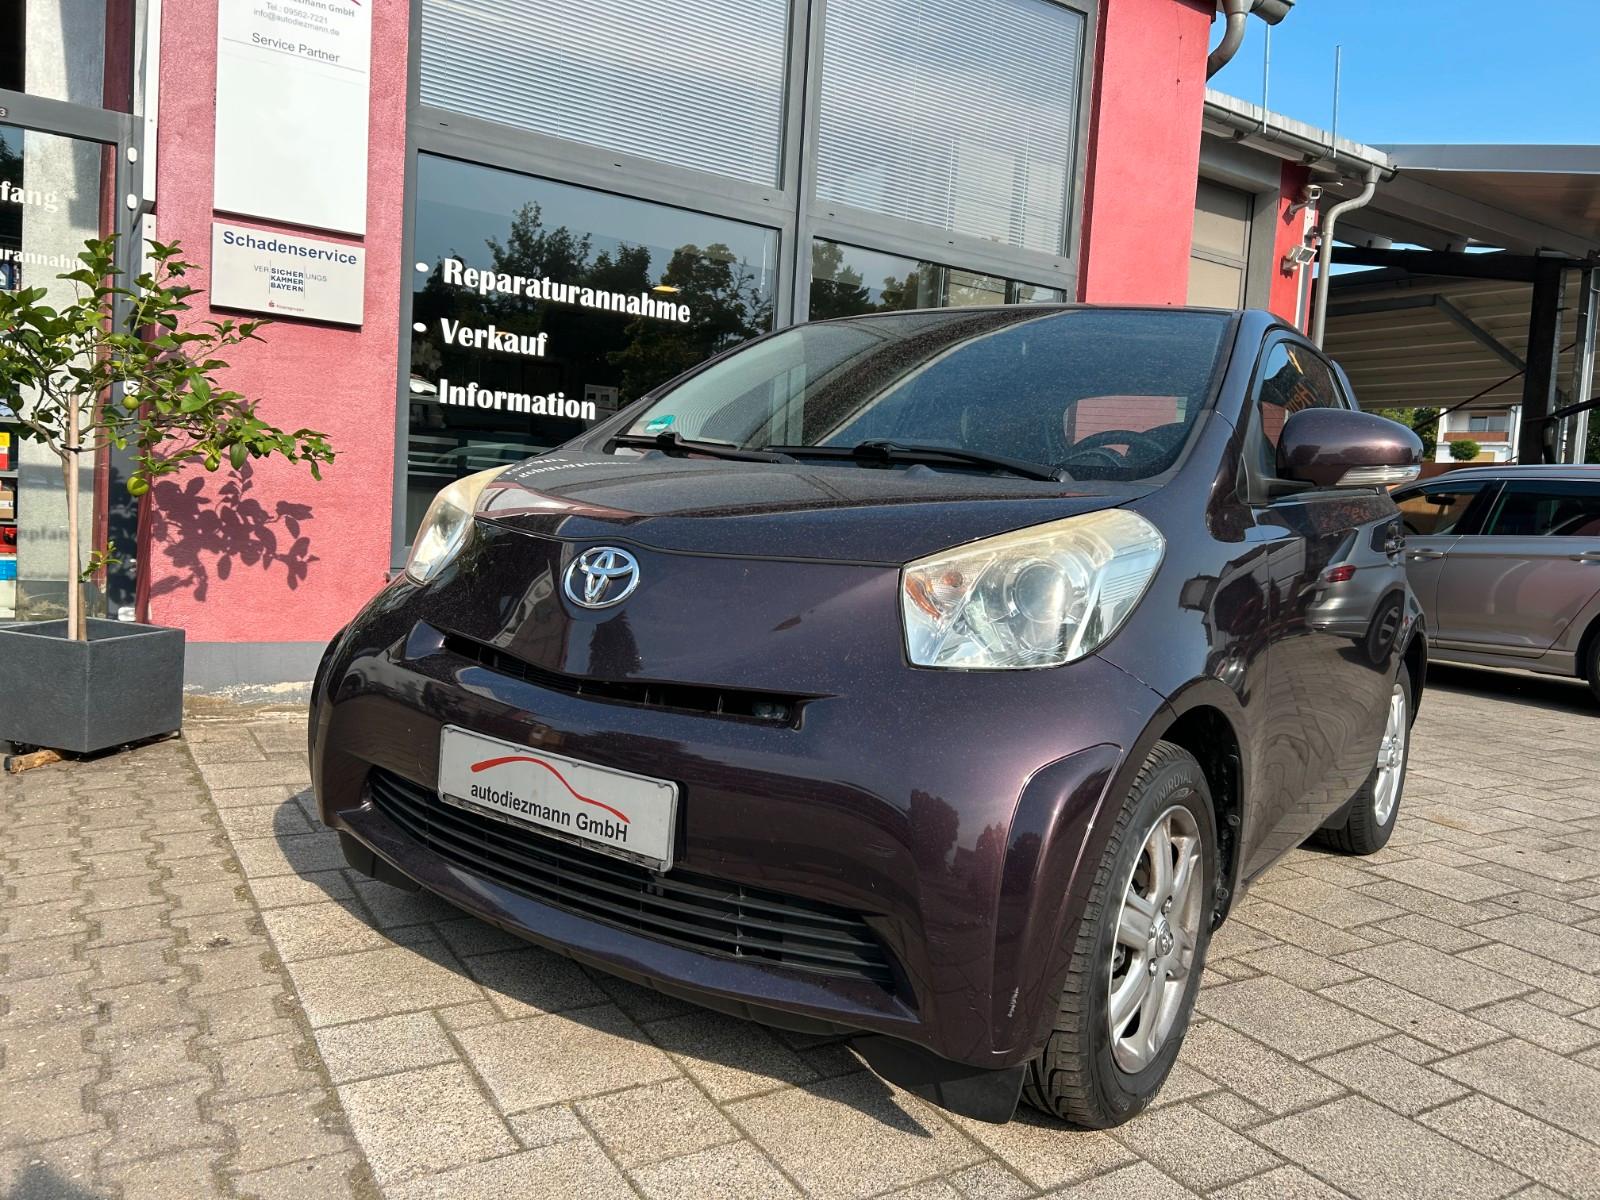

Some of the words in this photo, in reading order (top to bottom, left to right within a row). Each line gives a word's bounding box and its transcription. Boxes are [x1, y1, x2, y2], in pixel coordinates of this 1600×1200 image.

[253, 8, 340, 36] info@autodiezmann.de
[283, 6, 328, 25] 09562-7221
[328, 3, 355, 17] GmbH
[252, 32, 295, 52] Service
[298, 43, 341, 63] Partner
[223, 231, 357, 265] Schadenservice
[271, 267, 304, 279] SICHER
[271, 275, 304, 286] KAMMER
[271, 282, 304, 293] BAYERN
[443, 258, 691, 323] Reparaturannahme
[440, 317, 548, 357] Verkauf
[439, 378, 596, 421] Information
[471, 783, 571, 826] autodiezmann
[575, 812, 628, 842] GmbH
